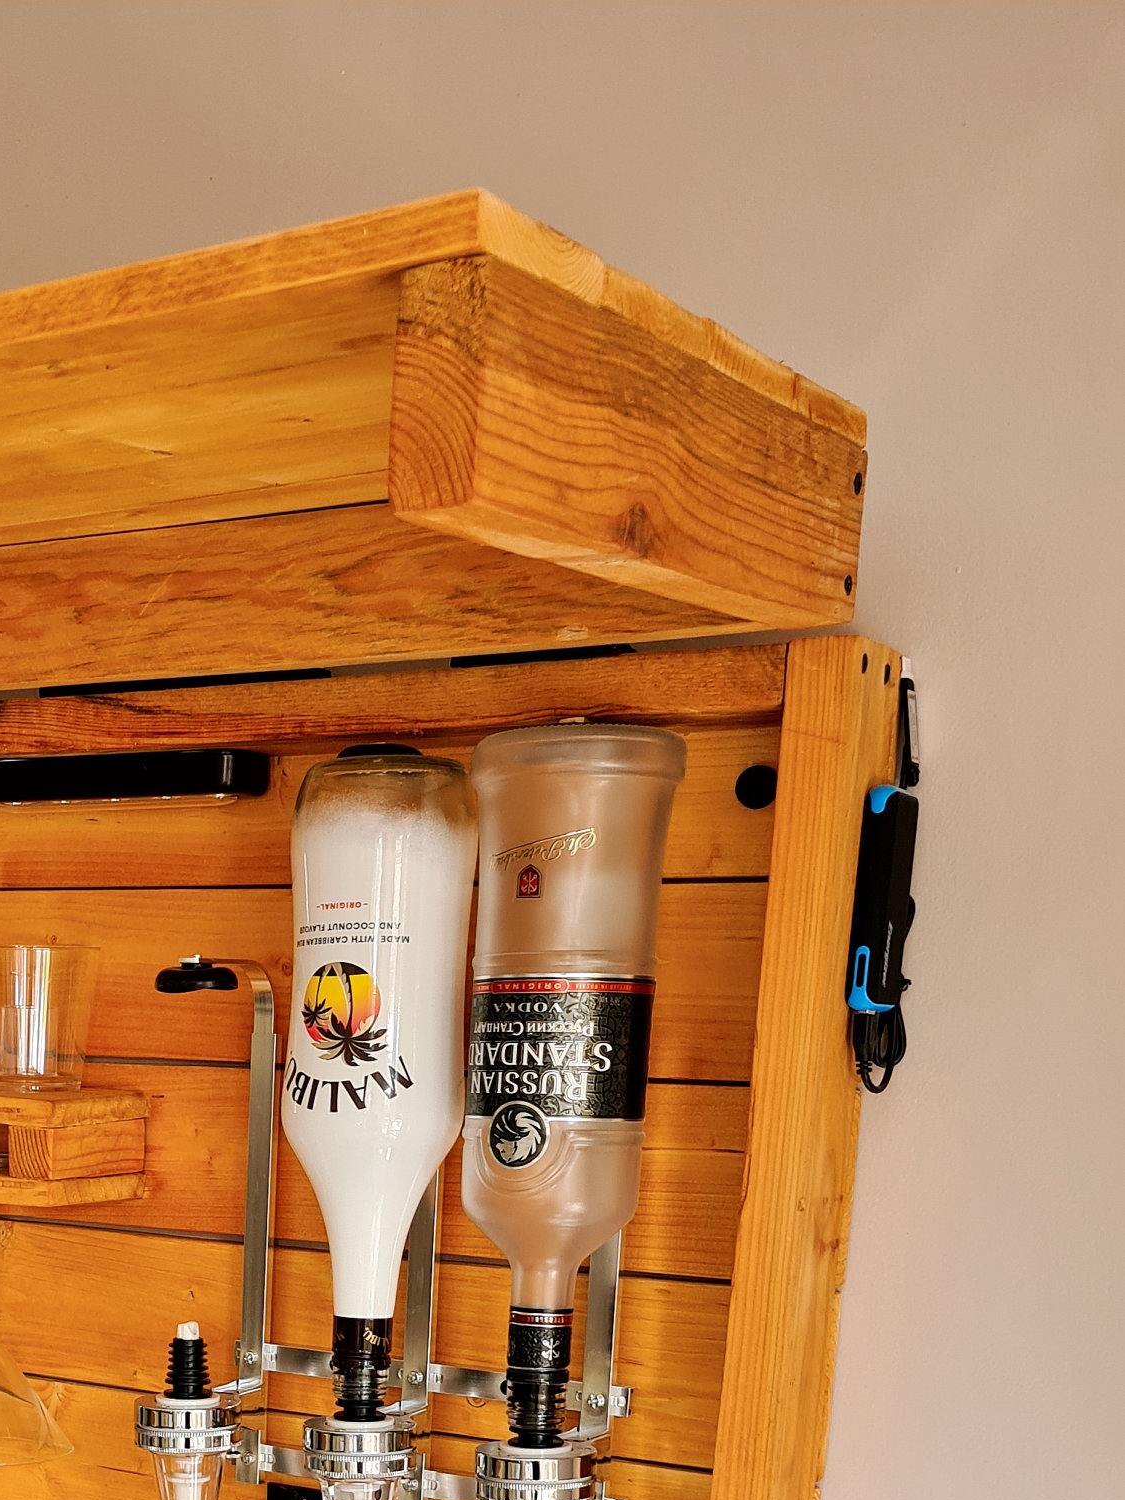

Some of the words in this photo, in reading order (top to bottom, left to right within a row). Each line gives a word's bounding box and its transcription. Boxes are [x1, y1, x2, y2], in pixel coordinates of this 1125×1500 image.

[327, 922, 376, 931] COCONUT
[379, 922, 402, 930] AND
[305, 935, 348, 946] CARIBBEAN
[380, 935, 410, 944] MADE
[497, 982, 563, 991] ORIGINAL
[493, 1001, 564, 1014] VODKA
[468, 1040, 613, 1072] STANDARD
[284, 1055, 414, 1113] MALIBU
[470, 1069, 590, 1101] RUSSIAN
